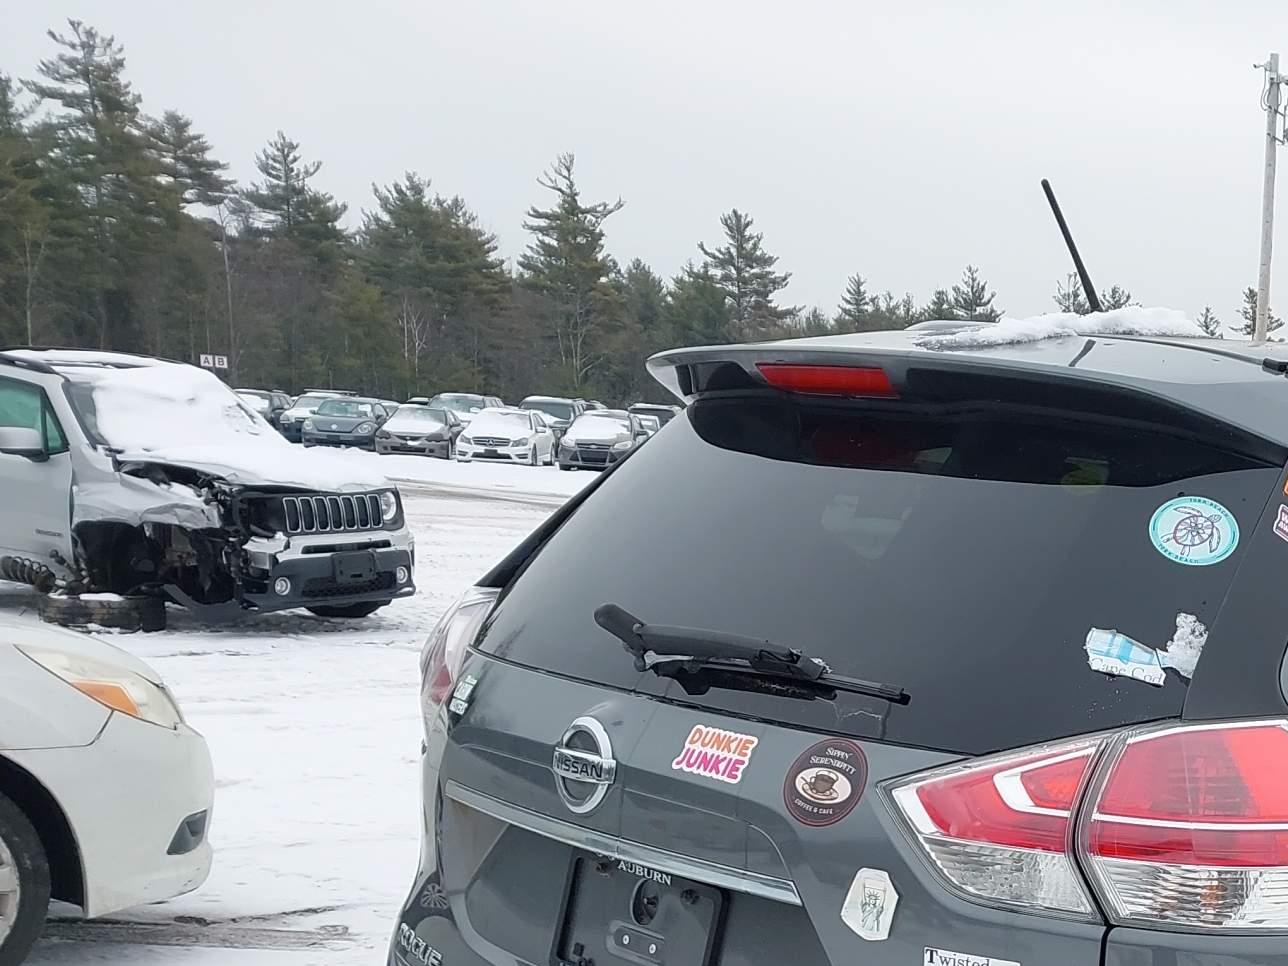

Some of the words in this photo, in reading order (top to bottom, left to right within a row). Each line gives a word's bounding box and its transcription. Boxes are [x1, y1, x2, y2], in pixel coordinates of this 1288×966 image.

[203, 356, 210, 365] A
[217, 357, 225, 366] B
[1131, 667, 1164, 684] Cod
[687, 727, 755, 758] DUNKIE
[554, 750, 603, 779] NISSAN
[675, 747, 746, 780] JUNKIE
[794, 798, 813, 812] COFFEE
[617, 860, 673, 886] AUBURN
